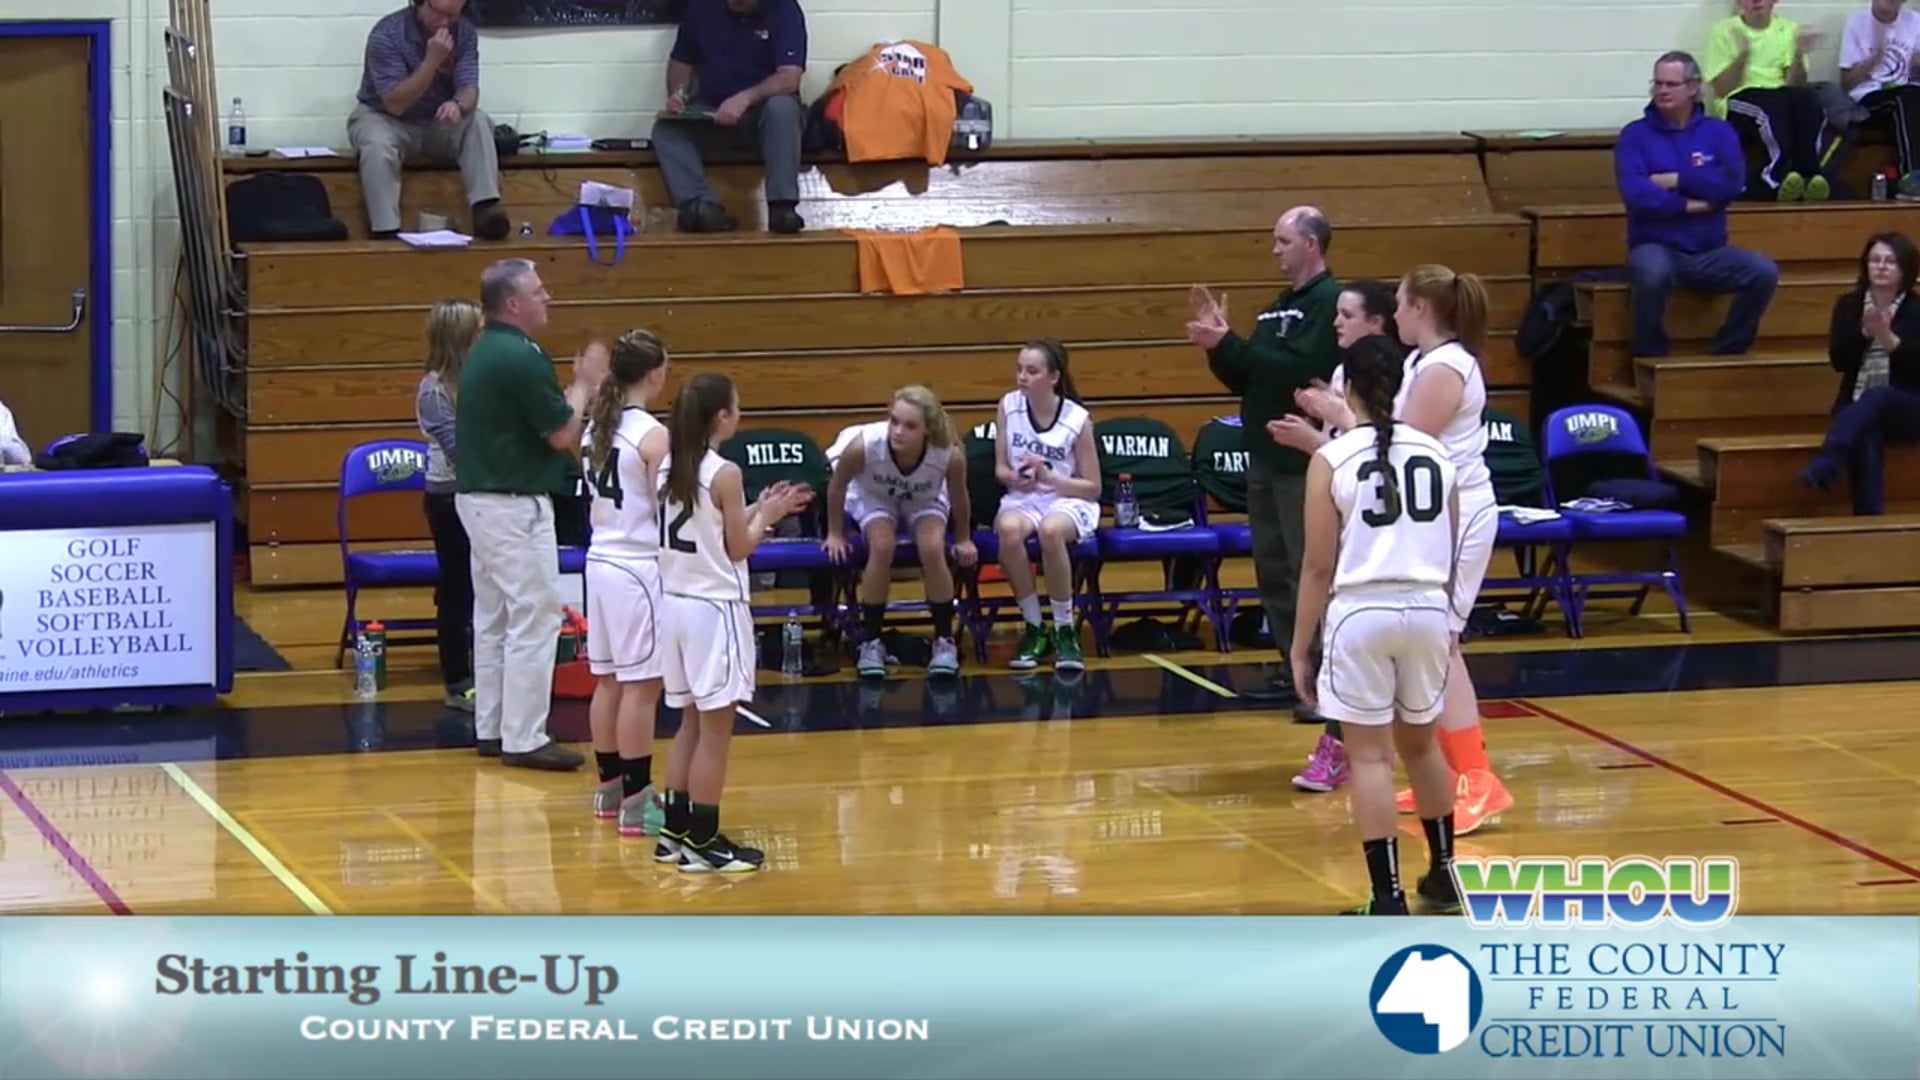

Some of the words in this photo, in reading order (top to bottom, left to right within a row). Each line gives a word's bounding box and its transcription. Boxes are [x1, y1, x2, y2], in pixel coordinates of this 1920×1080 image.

[1565, 412, 1618, 433] UMPI
[746, 443, 803, 465] MILES
[1012, 432, 1066, 461] EAGLES
[1102, 435, 1169, 458] WARMAN
[366, 448, 425, 471] UMPI
[1356, 455, 1443, 528] 30
[67, 538, 141, 558] GOLF
[50, 561, 157, 583] SOCCER
[38, 585, 172, 609] BASEBALL
[36, 610, 173, 634] SOFTBALL
[17, 633, 193, 659] VOLLEYBALL
